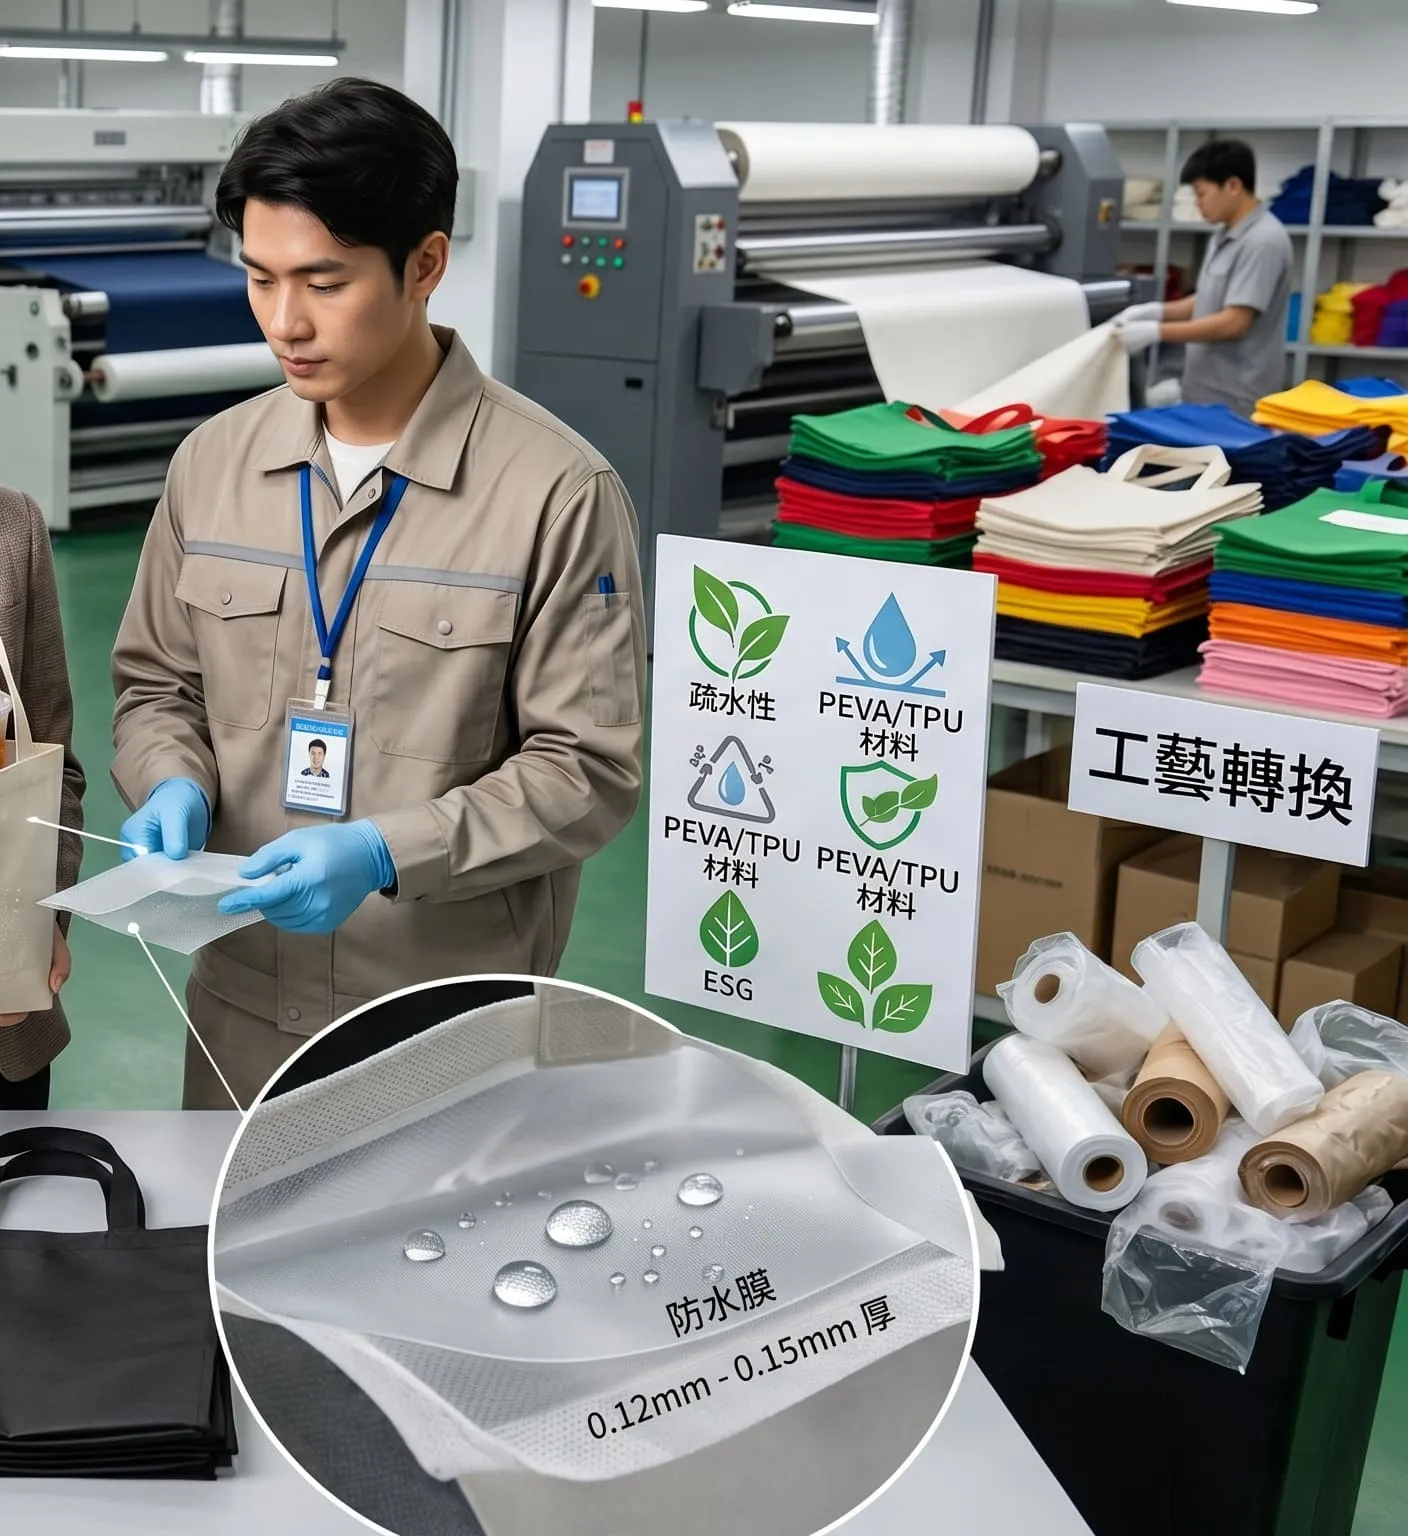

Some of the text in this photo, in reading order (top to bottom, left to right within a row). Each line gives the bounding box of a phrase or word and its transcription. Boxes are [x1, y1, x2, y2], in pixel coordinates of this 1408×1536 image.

[689, 682, 776, 721] 疏水性
[819, 691, 963, 733] PEVA/TPU
[859, 727, 919, 762] 材料
[1088, 727, 1353, 827] 工藝轉換
[664, 815, 801, 862] PEVA/TPU
[703, 853, 759, 889] 材料
[817, 846, 959, 893] PEVA/TPU
[856, 883, 916, 920] 材料
[704, 970, 753, 1001] ESG
